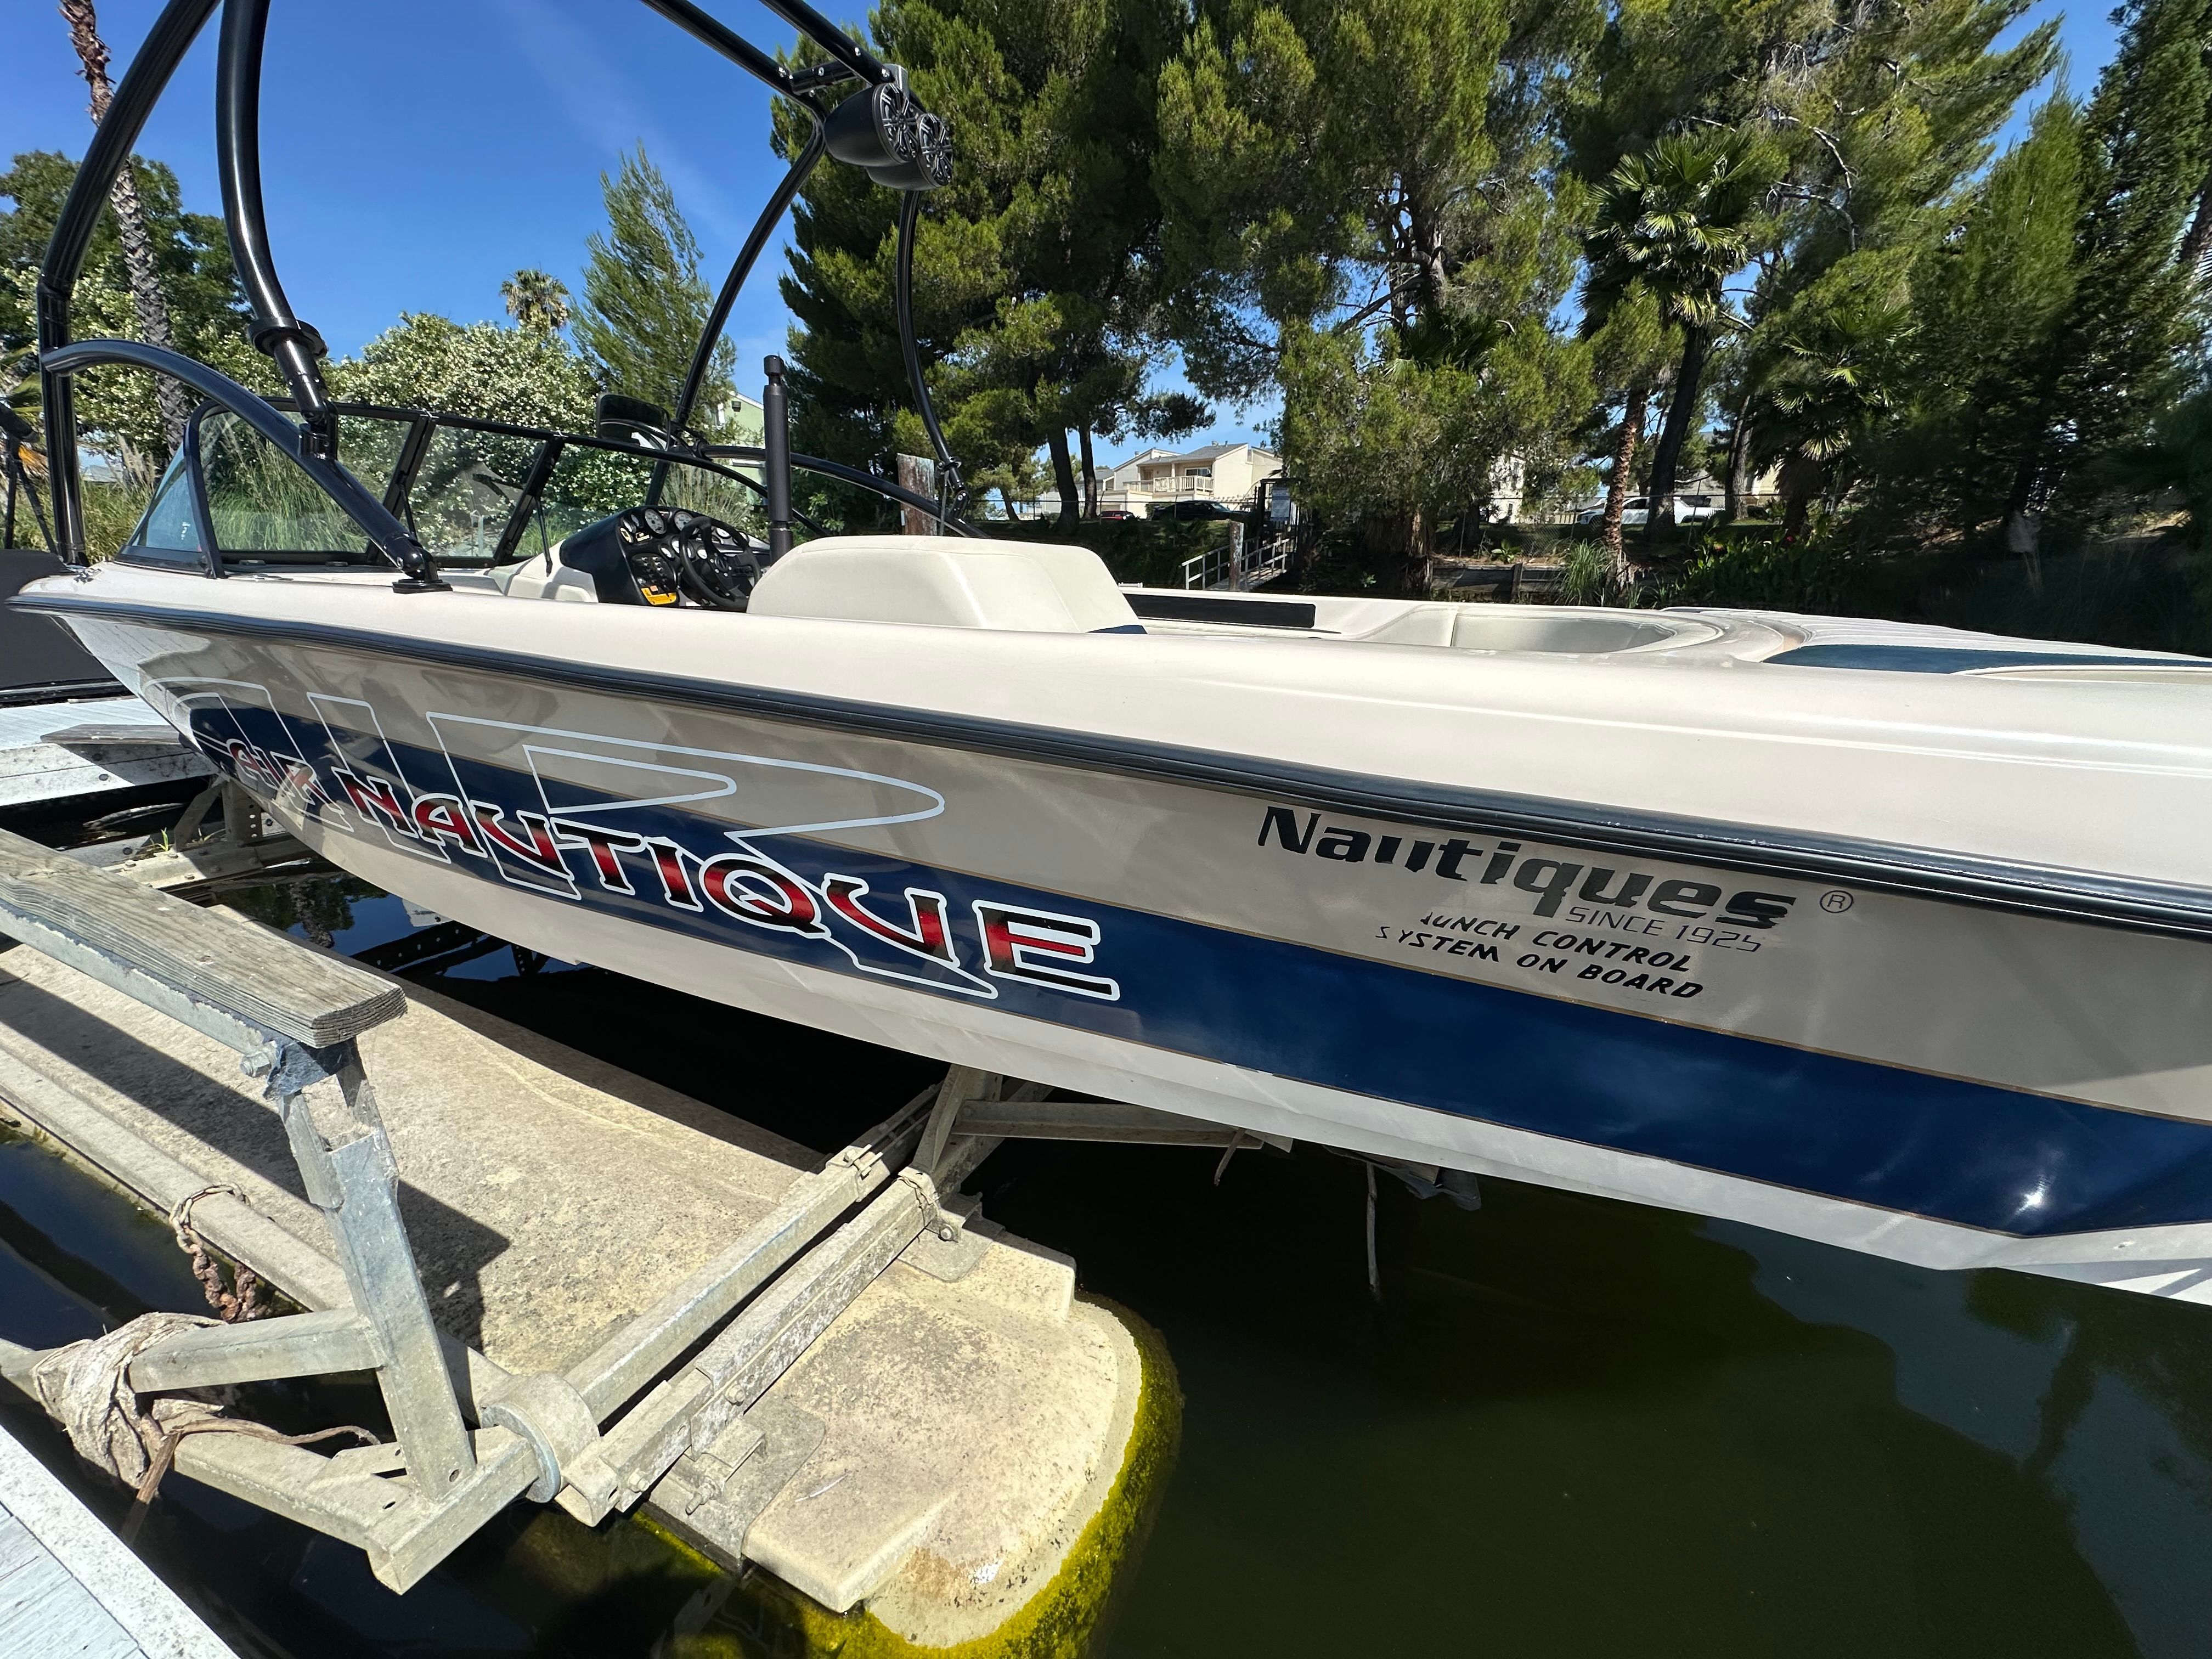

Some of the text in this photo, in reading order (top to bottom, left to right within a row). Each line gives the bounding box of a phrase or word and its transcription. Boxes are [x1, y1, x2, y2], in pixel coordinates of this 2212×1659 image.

[225, 738, 1120, 1001] AIR NAUTIQUE
[1258, 806, 1797, 929] Nautiques
[1375, 926, 1703, 998] SYSTEM ON BOARD
[1532, 931, 1691, 972] CONTROL
[1566, 907, 1762, 952] SINCE 1925
